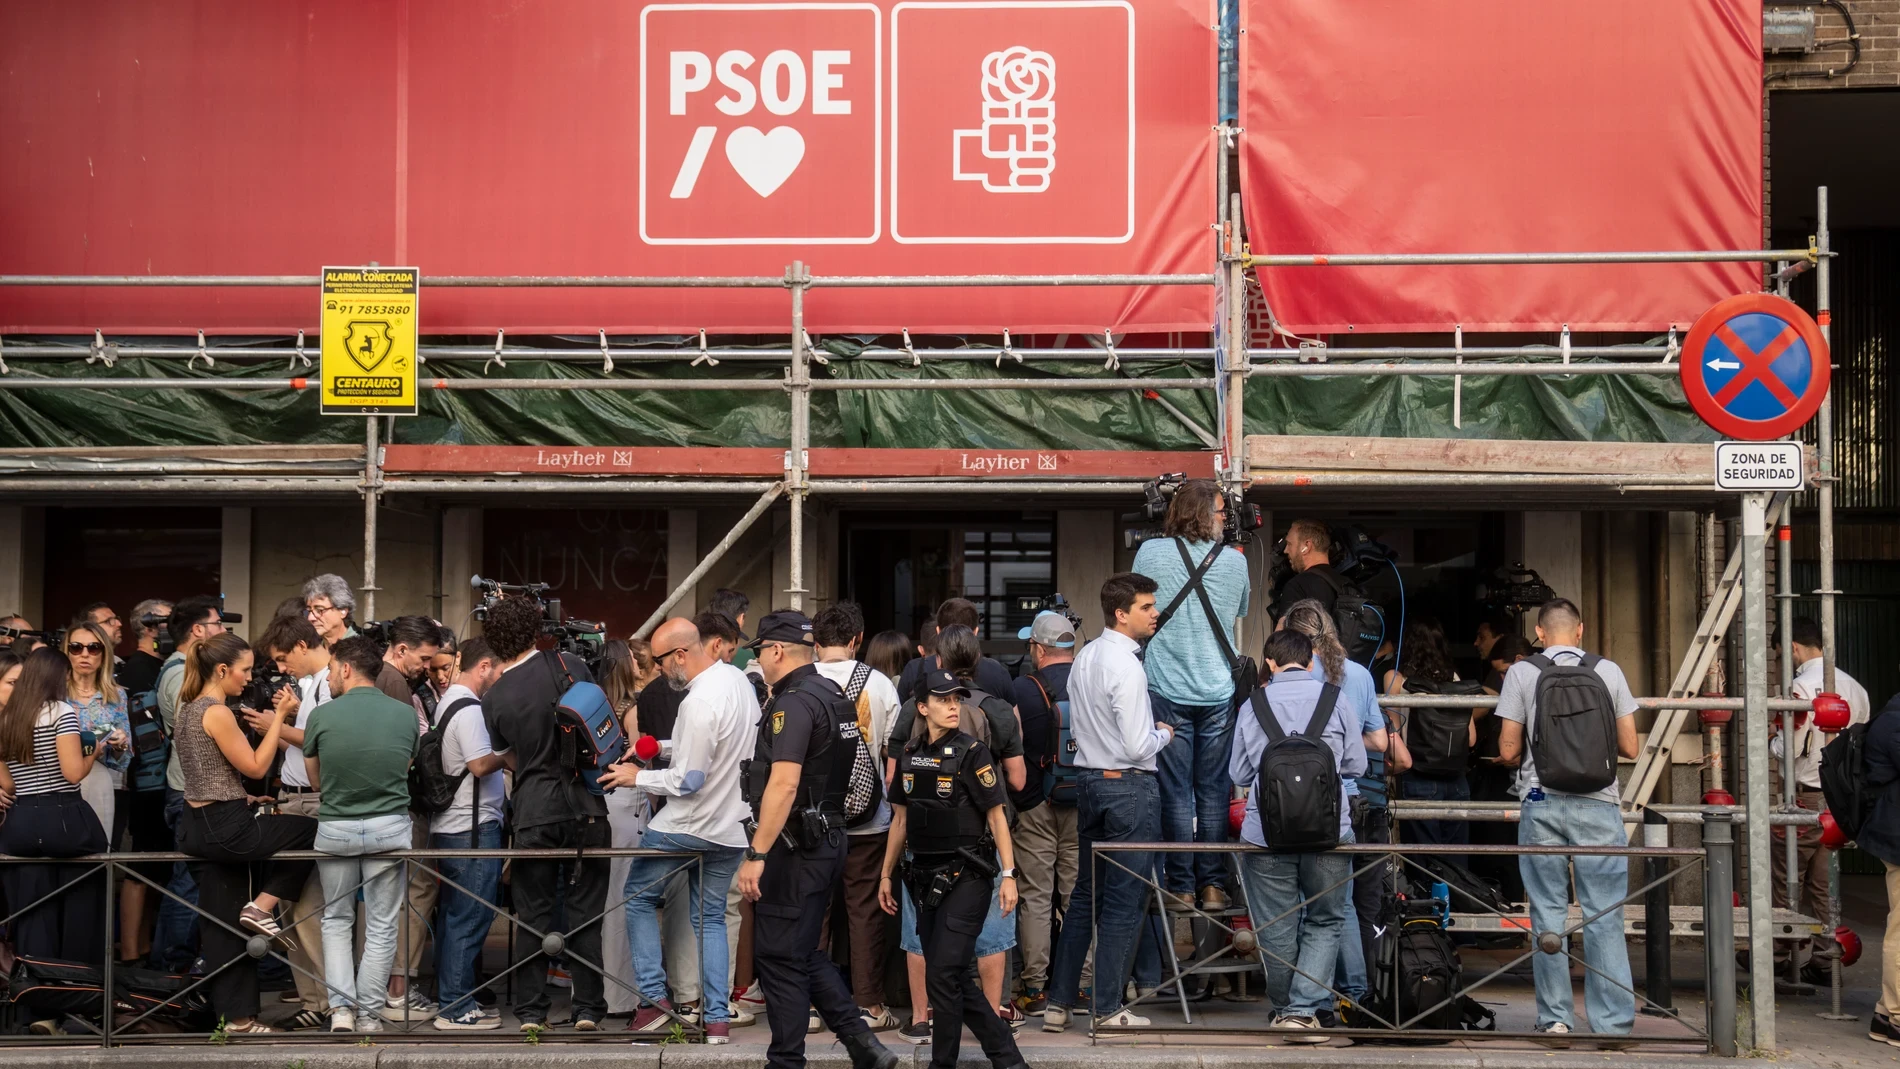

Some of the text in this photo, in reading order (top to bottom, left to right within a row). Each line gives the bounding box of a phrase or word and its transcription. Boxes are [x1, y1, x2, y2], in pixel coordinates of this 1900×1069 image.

[670, 49, 852, 116] PSOE
[325, 272, 413, 282] ALARMA CONECTADA
[339, 305, 410, 315] 91 7853880
[336, 378, 400, 388] CENTAURO
[537, 450, 606, 469] Layher
[961, 453, 1030, 473] Layher
[1731, 453, 1787, 464] ZONA DE
[1724, 468, 1795, 480] SEGURIDAD
[500, 545, 668, 592] NUNCA
